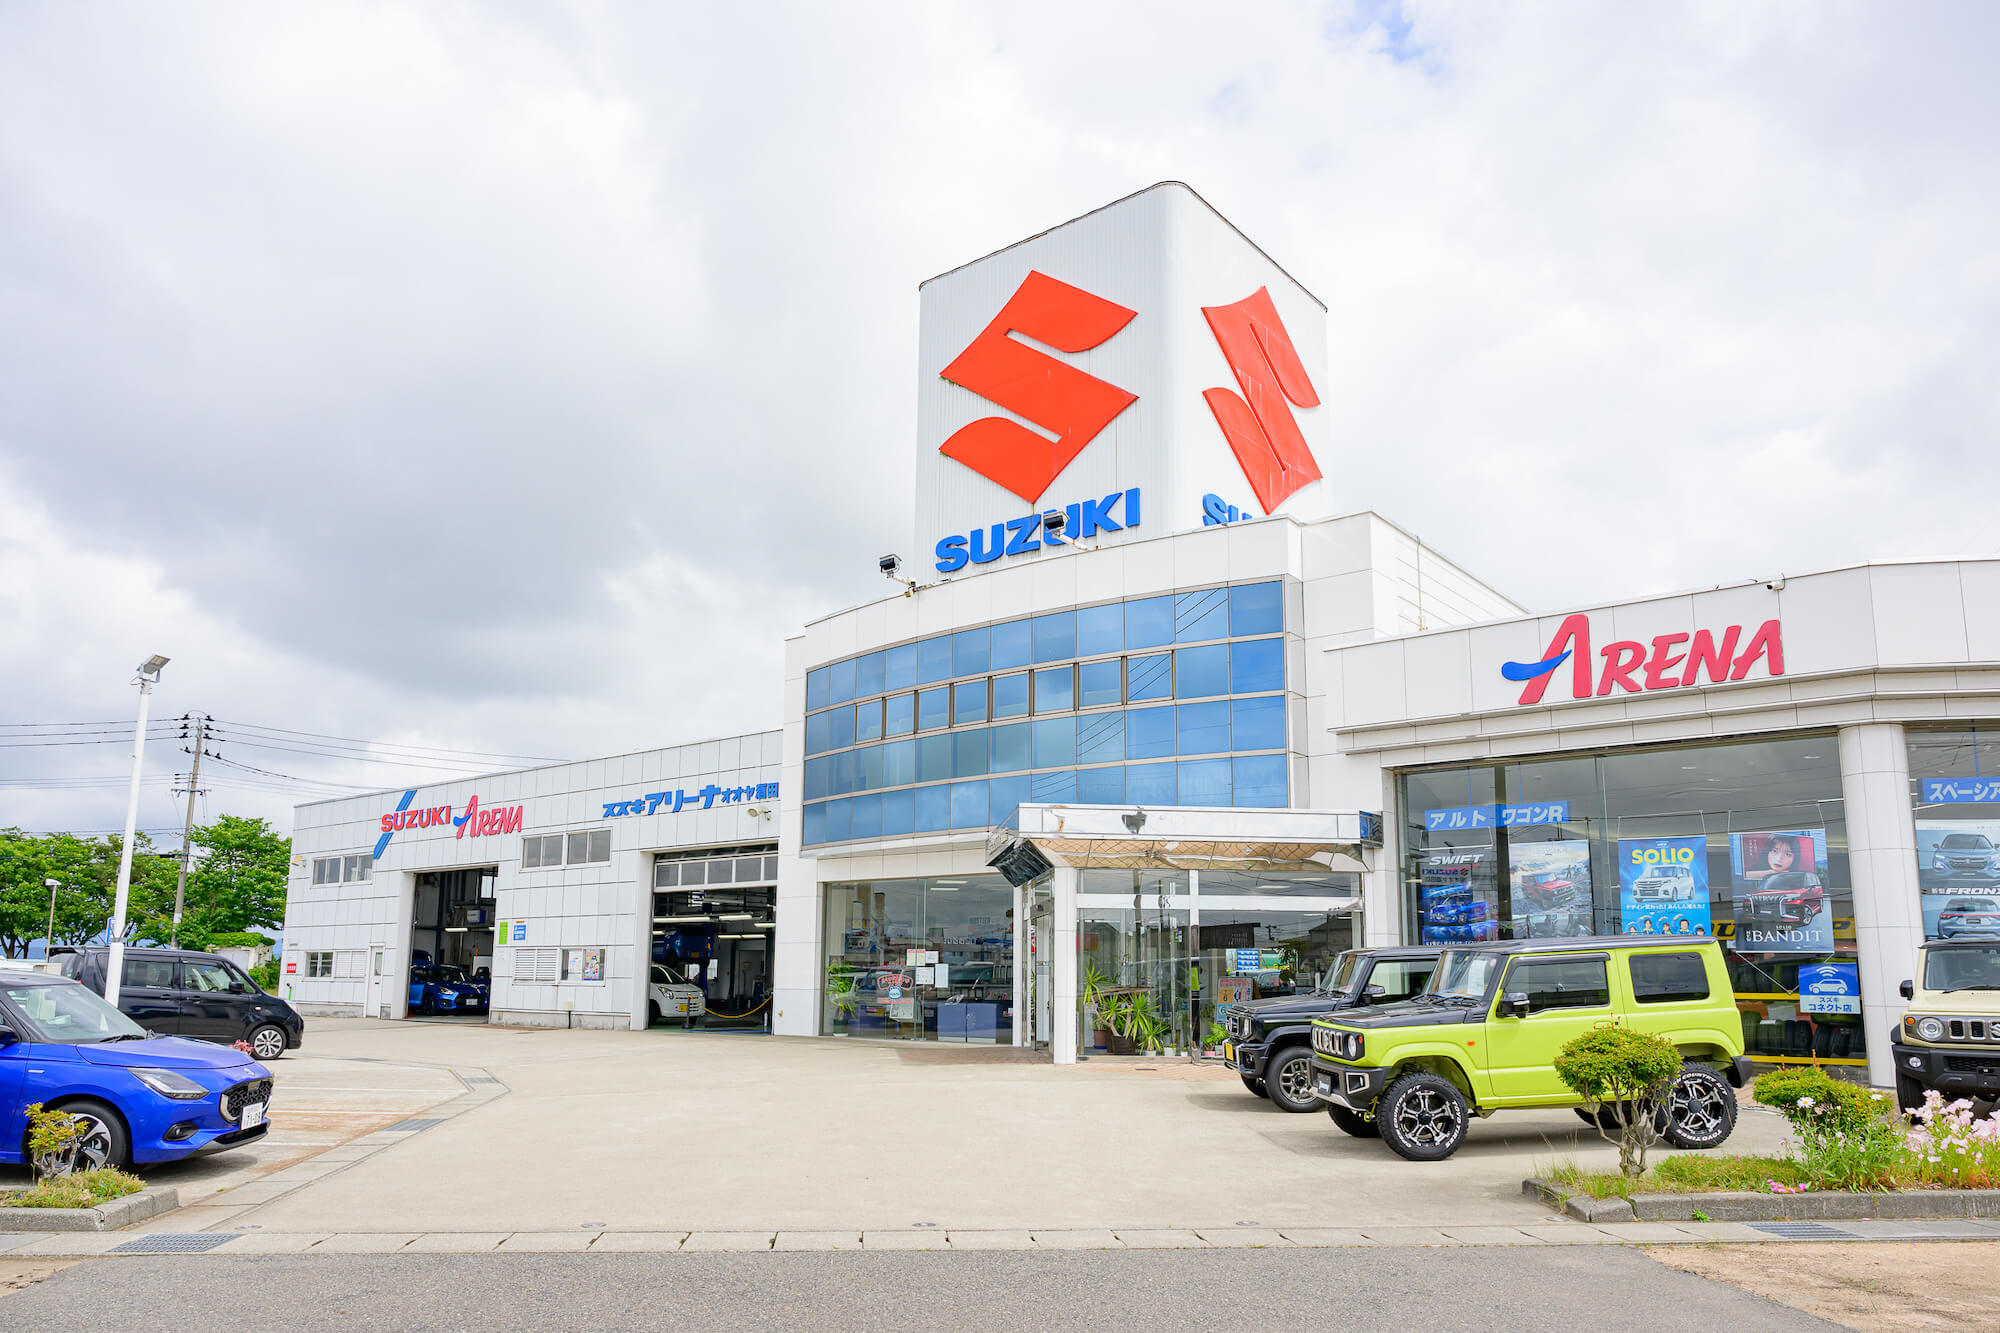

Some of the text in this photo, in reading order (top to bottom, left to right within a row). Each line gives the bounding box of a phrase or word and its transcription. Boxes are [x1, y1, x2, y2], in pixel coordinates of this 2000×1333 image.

[935, 487, 1141, 573] SUZUKI
[1501, 613, 1785, 705] ARENA
[381, 795, 524, 840] SUZUKI ARENA
[1429, 810, 1487, 829] アルト
[1502, 805, 1563, 825] ワゴンR
[1429, 854, 1485, 866] SWIFT
[1631, 848, 1695, 865] SOLIO
[1946, 887, 2000, 895] FRON
[1752, 929, 1824, 942] BANDIT
[1807, 1003, 1853, 1012] コネクト店
[1682, 1072, 1717, 1083] COUNTRY
[1393, 1093, 1407, 1128] COUNTRY
[1445, 1100, 1462, 1149] TOYO TIRES
[1676, 1128, 1723, 1142] TOYO TIRES
